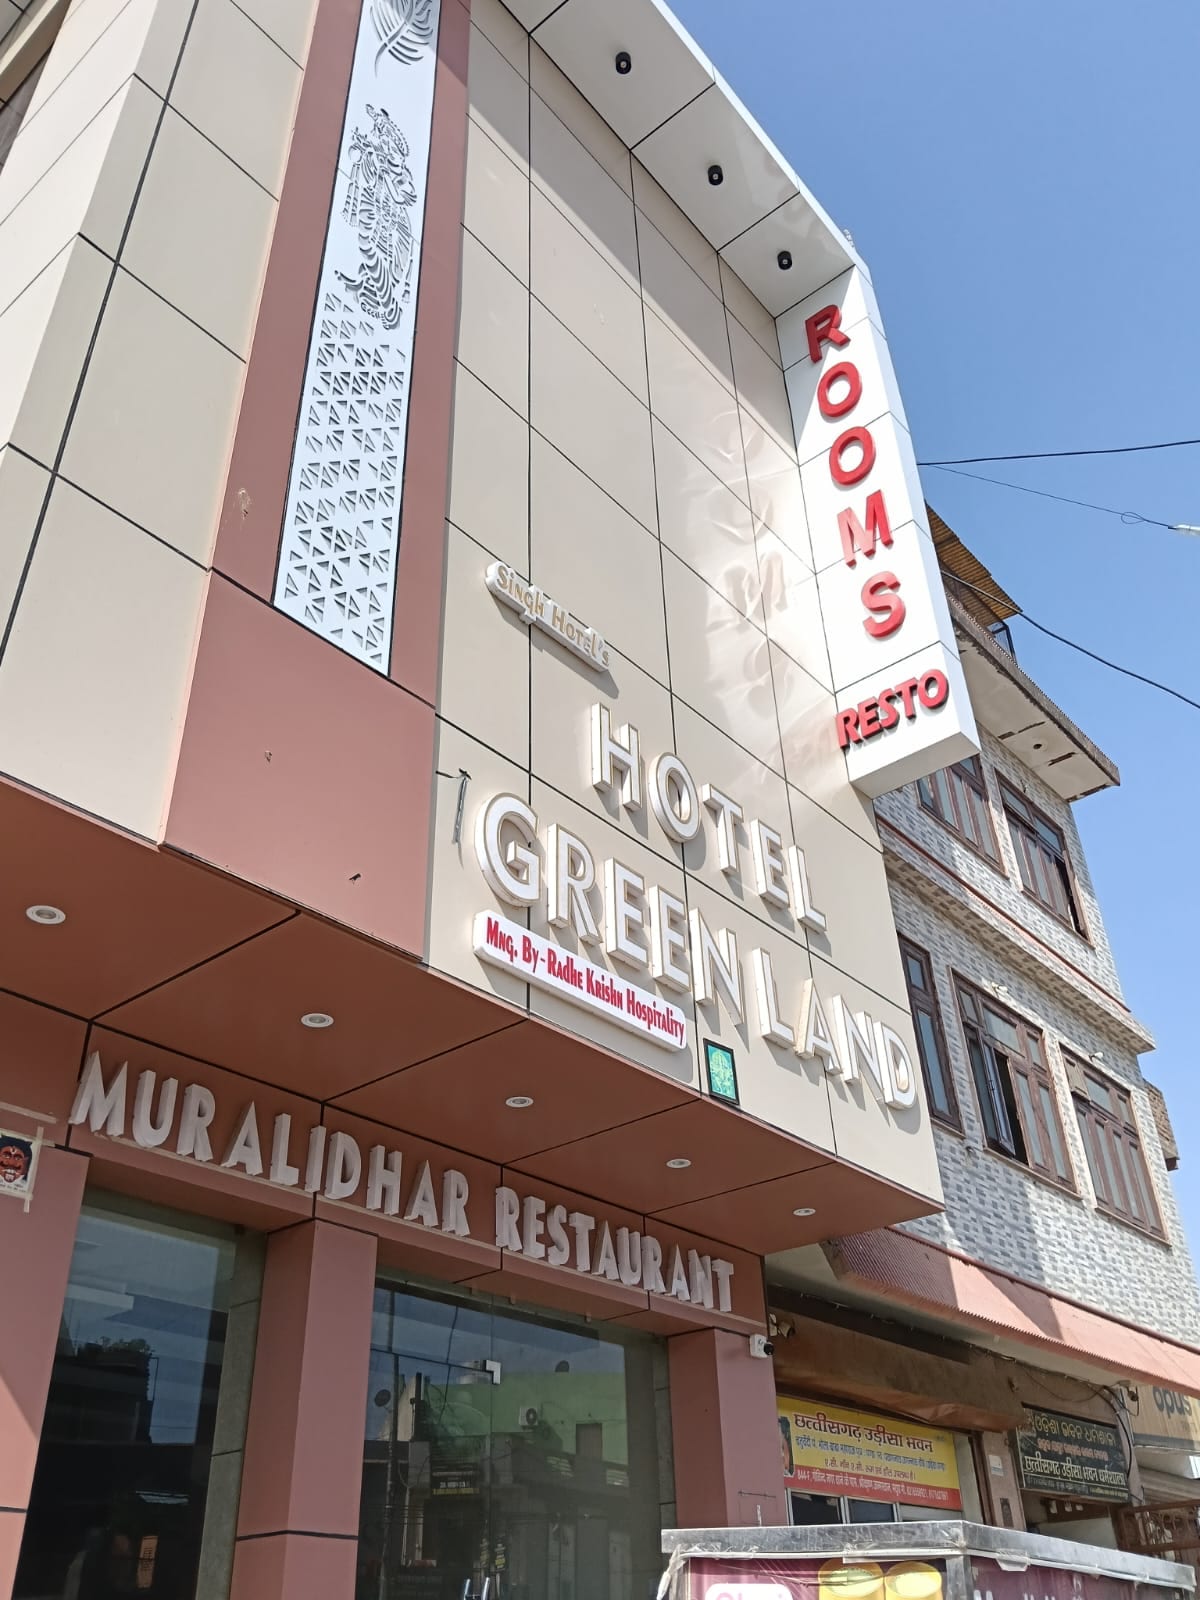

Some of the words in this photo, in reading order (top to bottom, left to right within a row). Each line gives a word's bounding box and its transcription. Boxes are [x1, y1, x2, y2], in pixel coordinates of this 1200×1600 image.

[804, 303, 907, 638] ROOMS
[836, 668, 949, 749] RESTO
[591, 702, 827, 934] HOTEL
[474, 792, 917, 1110] GREENLAND
[626, 988, 685, 1047] Hospitality
[69, 1050, 472, 1237] MURALIDHAR
[494, 1186, 734, 1312] RESTAURANT
[864, 1425, 903, 1447] उड़ीसा
[906, 1436, 934, 1453] भवन
[1082, 1466, 1098, 1482] भवन
